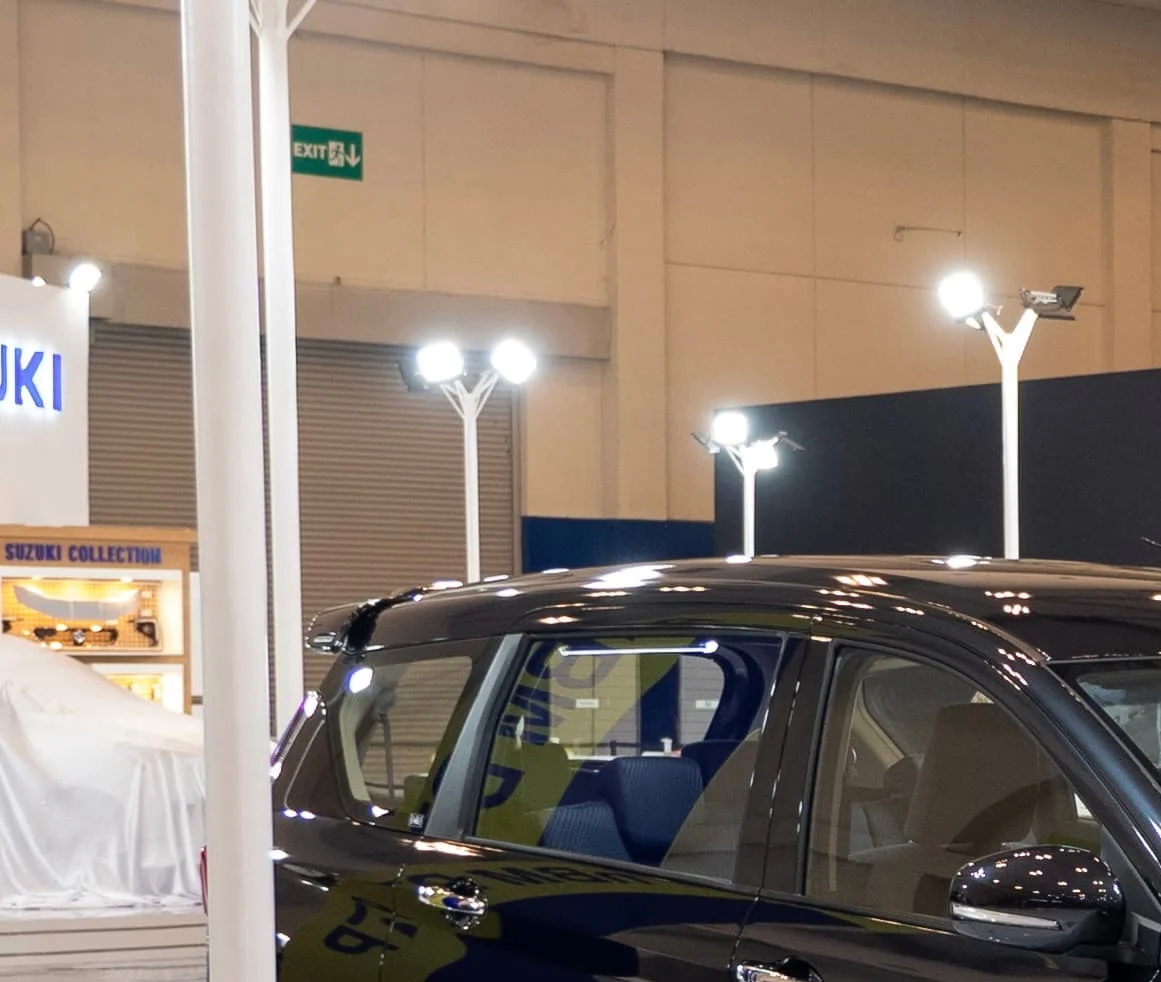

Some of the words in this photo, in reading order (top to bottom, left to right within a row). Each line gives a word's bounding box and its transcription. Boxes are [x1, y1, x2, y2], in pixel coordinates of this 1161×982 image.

[293, 142, 327, 160] EXIT
[5, 544, 62, 561] SUZUKI
[68, 545, 162, 564] COLLECTION
